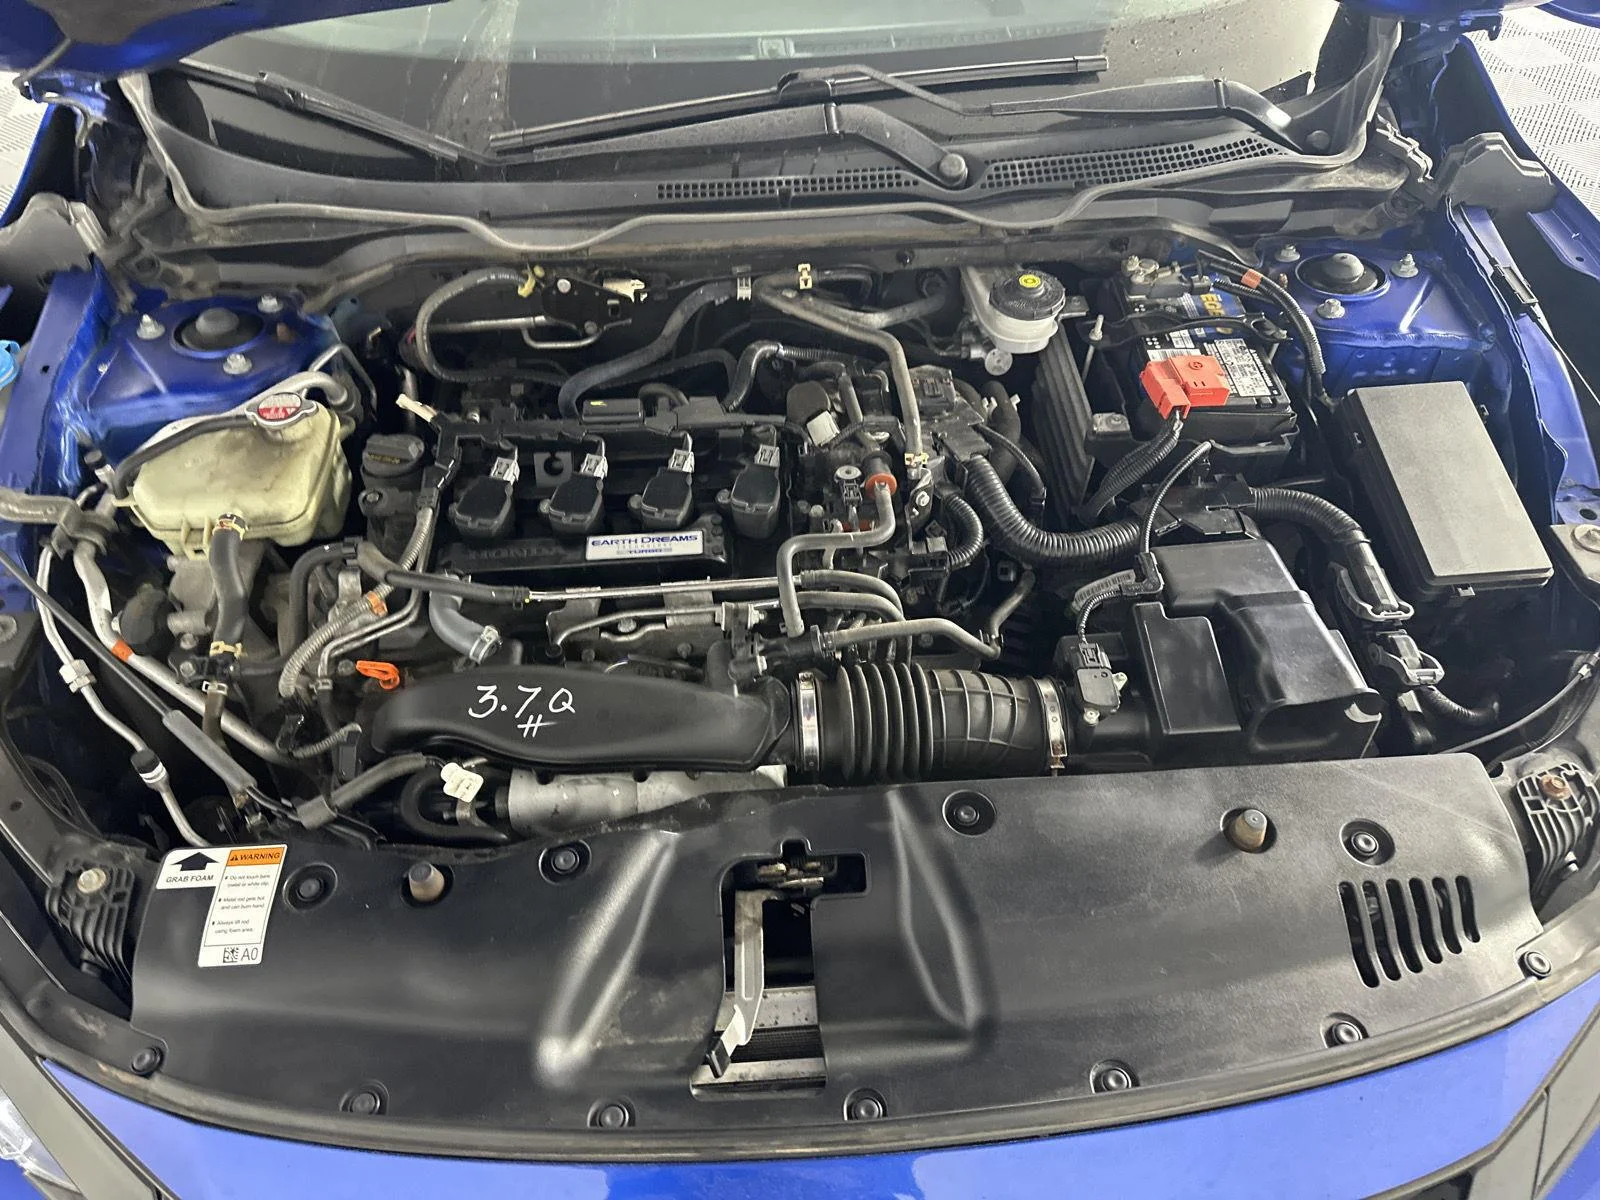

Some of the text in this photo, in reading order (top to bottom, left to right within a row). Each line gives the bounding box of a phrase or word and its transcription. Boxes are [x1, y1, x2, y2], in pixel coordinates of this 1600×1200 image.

[591, 535, 698, 546] EARTH DREAMS
[240, 852, 280, 860] WARNING
